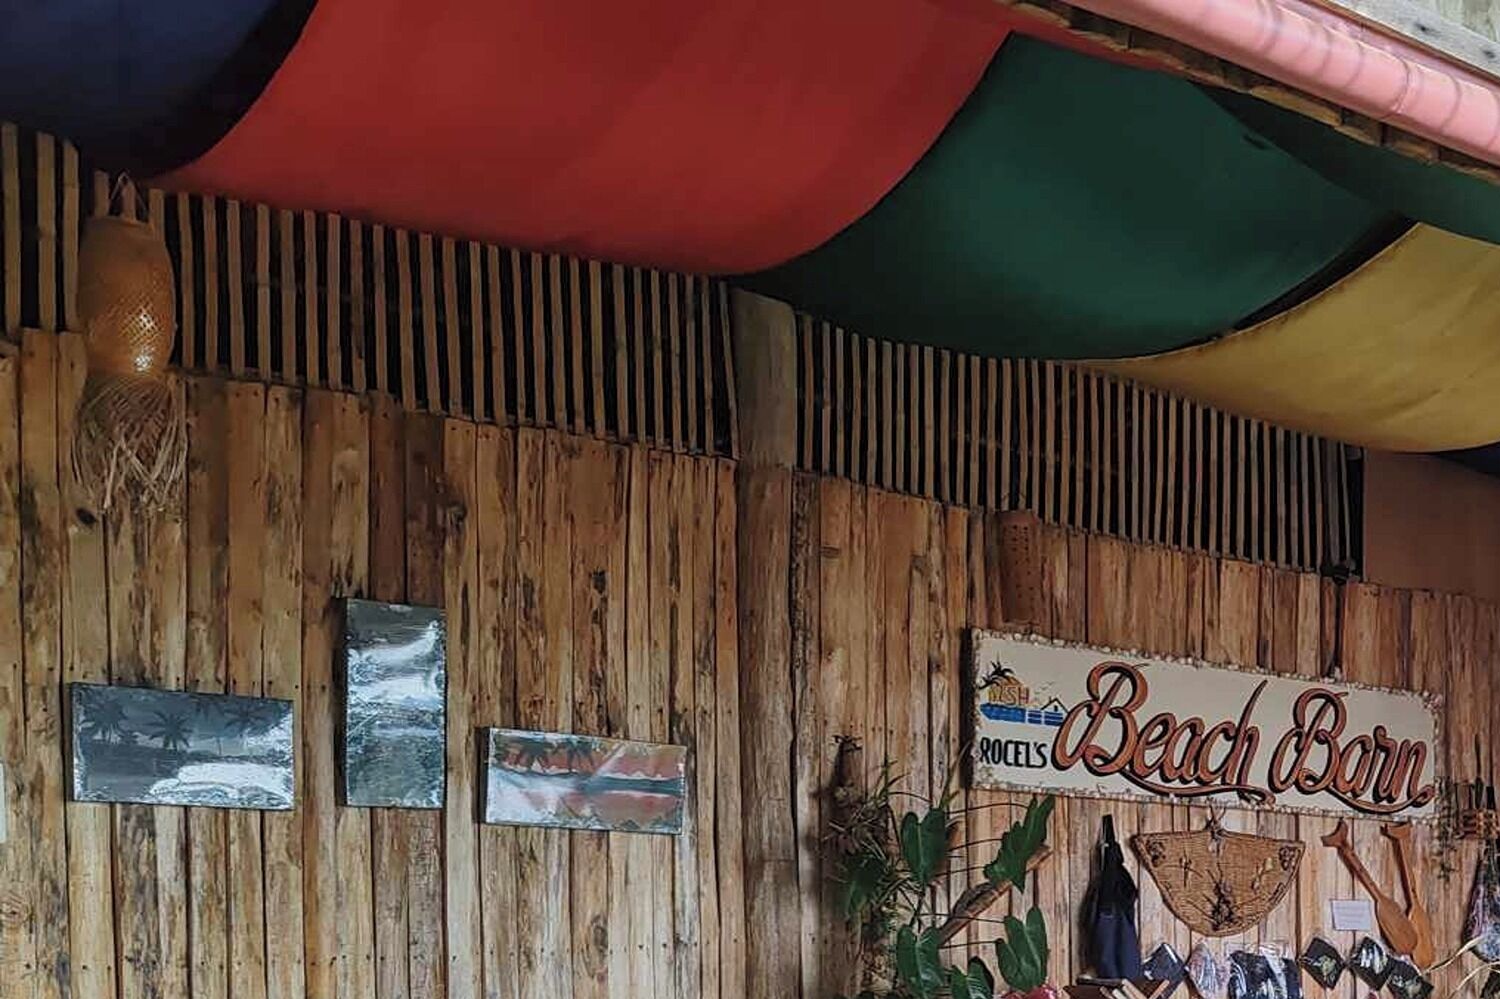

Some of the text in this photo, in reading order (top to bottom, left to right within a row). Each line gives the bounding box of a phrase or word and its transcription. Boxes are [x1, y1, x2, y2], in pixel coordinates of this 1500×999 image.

[980, 736, 1048, 769] ROCEL'S
[1051, 660, 1436, 815] Beach Barn
